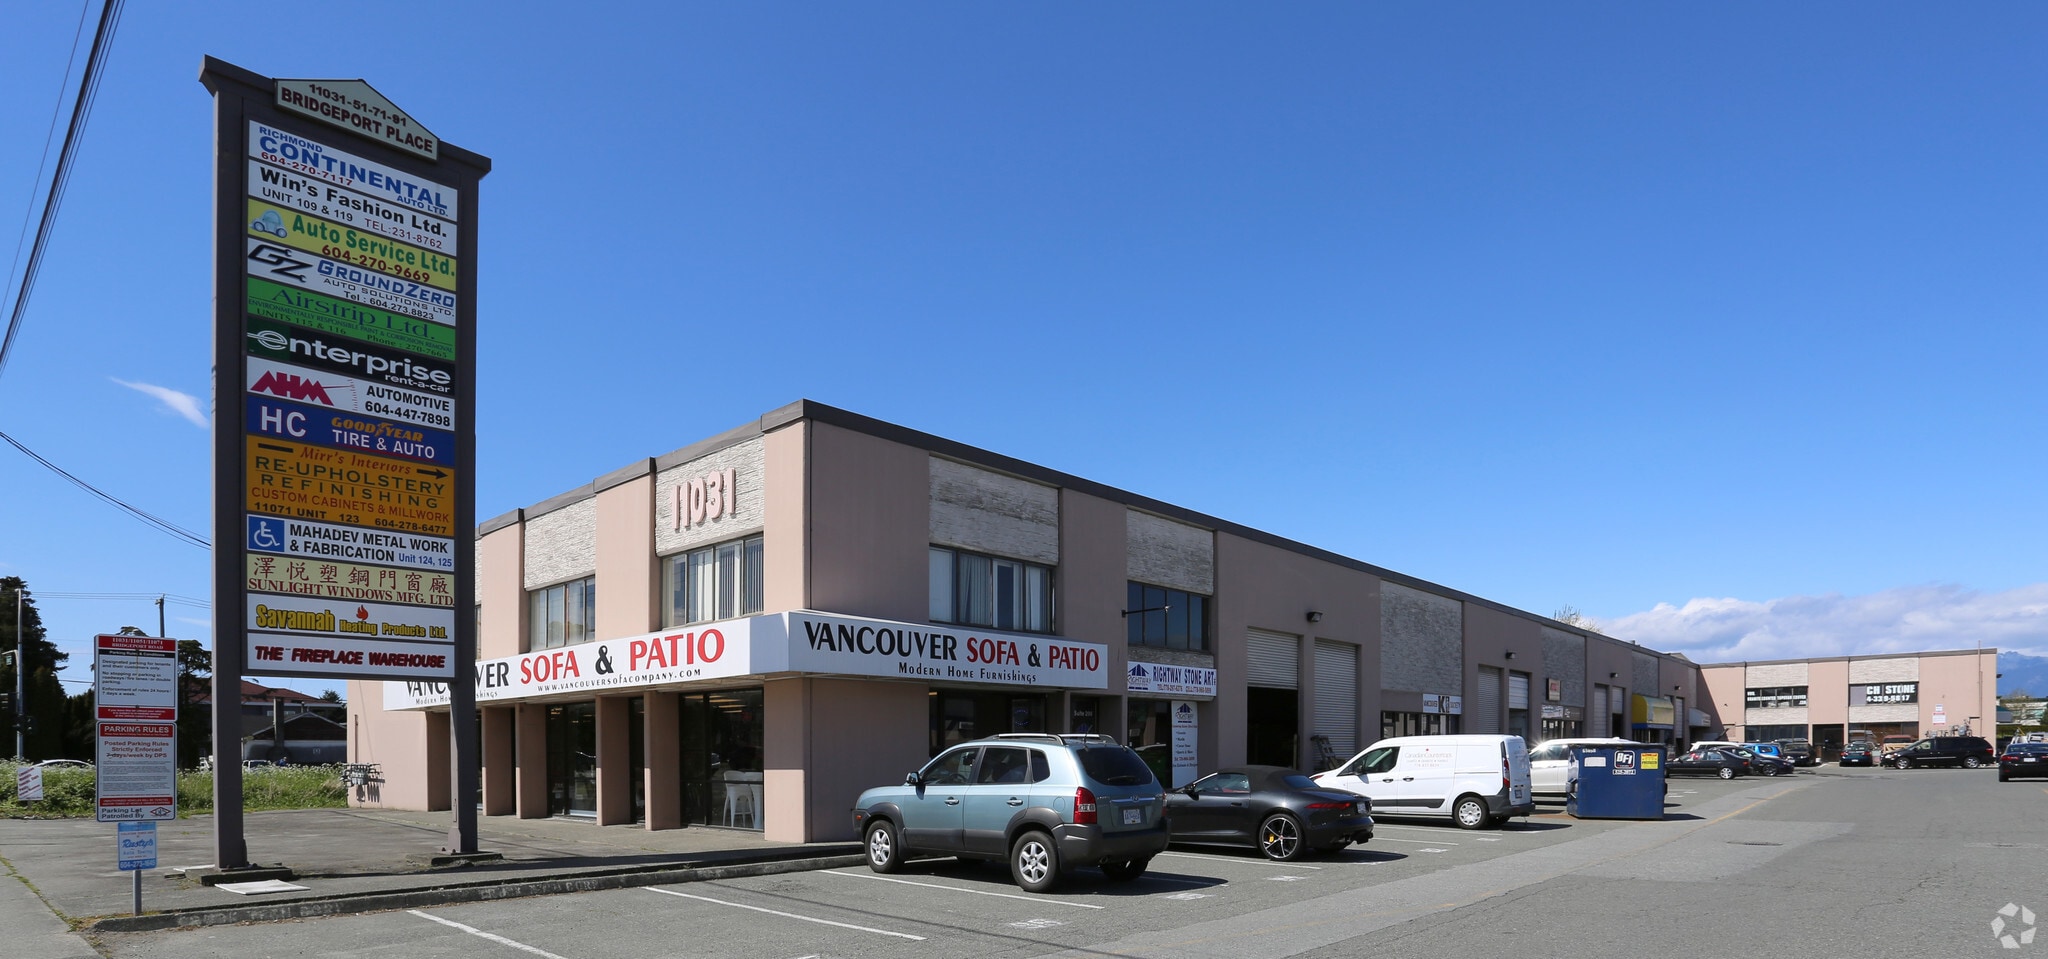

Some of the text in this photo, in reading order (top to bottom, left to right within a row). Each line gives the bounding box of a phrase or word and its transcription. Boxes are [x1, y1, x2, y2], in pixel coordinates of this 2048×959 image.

[281, 87, 433, 153] BRIDGEPORT PLACE
[310, 84, 407, 127] 11031-51-71-91
[259, 126, 323, 153] RICHMOND
[260, 136, 448, 210] CONTINENTAL
[261, 151, 353, 186] 604-270-7117
[260, 167, 447, 237] Win's Fashion Ltd.
[262, 187, 353, 222] UNIT 109 & 119
[396, 195, 449, 217] AUTO LTD.
[292, 214, 456, 277] Auto Service Ltd.
[364, 218, 442, 249] TEL:231-8762
[321, 244, 430, 283] 604-270-9669
[323, 278, 455, 317] AUTO SOLUTIONS LTD.
[344, 290, 360, 301] Tel
[369, 298, 435, 320] 604.273.8823
[248, 299, 316, 321] ENVIRONMENTALLY
[316, 314, 360, 331] RESPONSIBLE
[360, 324, 379, 335] PAINT
[256, 308, 291, 322] UNITS
[296, 317, 313, 328] 115
[329, 325, 346, 335] 116
[271, 289, 436, 340] Airstrip Ltd.
[367, 334, 396, 347] Phone
[249, 330, 451, 384] enterprise
[251, 370, 334, 406] AHM
[384, 372, 450, 393] rent-a-car
[365, 401, 450, 427] 604-447-7898
[366, 385, 450, 412] AUTOMOTIVE
[261, 406, 307, 437] HC
[332, 429, 435, 459] TIRE & AUTO
[255, 455, 445, 496] RE-UPHOLSTERY
[300, 447, 412, 475] Mirr's Interiors
[251, 487, 450, 523] CUSTOM CABINETS & MILLWORK
[261, 473, 438, 509] REFINISHING
[670, 467, 737, 530] 11031
[254, 502, 447, 534] 11071 UNIT 123 604-278-6477
[289, 539, 395, 562] & FABRICATION
[290, 524, 448, 554] MAHADEV METAL WORK
[398, 552, 452, 567] Unit 124, 125
[248, 577, 323, 596] SUNLIGHT
[327, 584, 393, 602] WINDOWS
[396, 591, 427, 604] MFG.
[256, 604, 448, 639] Savannah Heating Products Ltd.
[255, 646, 446, 669] THE FIREPLACE WAREHOUSE
[520, 650, 581, 685] SOFA
[595, 645, 614, 675] &
[630, 628, 725, 672] PATIO
[803, 621, 1100, 672] VANCOUVER SOFA & PATIO
[898, 662, 1037, 684] Modern Home Furnishings
[1153, 666, 1182, 684] RIGHTWAY
[1184, 668, 1202, 685] STONE
[1885, 684, 1915, 694] STONE
[1616, 752, 1633, 765] BFI
